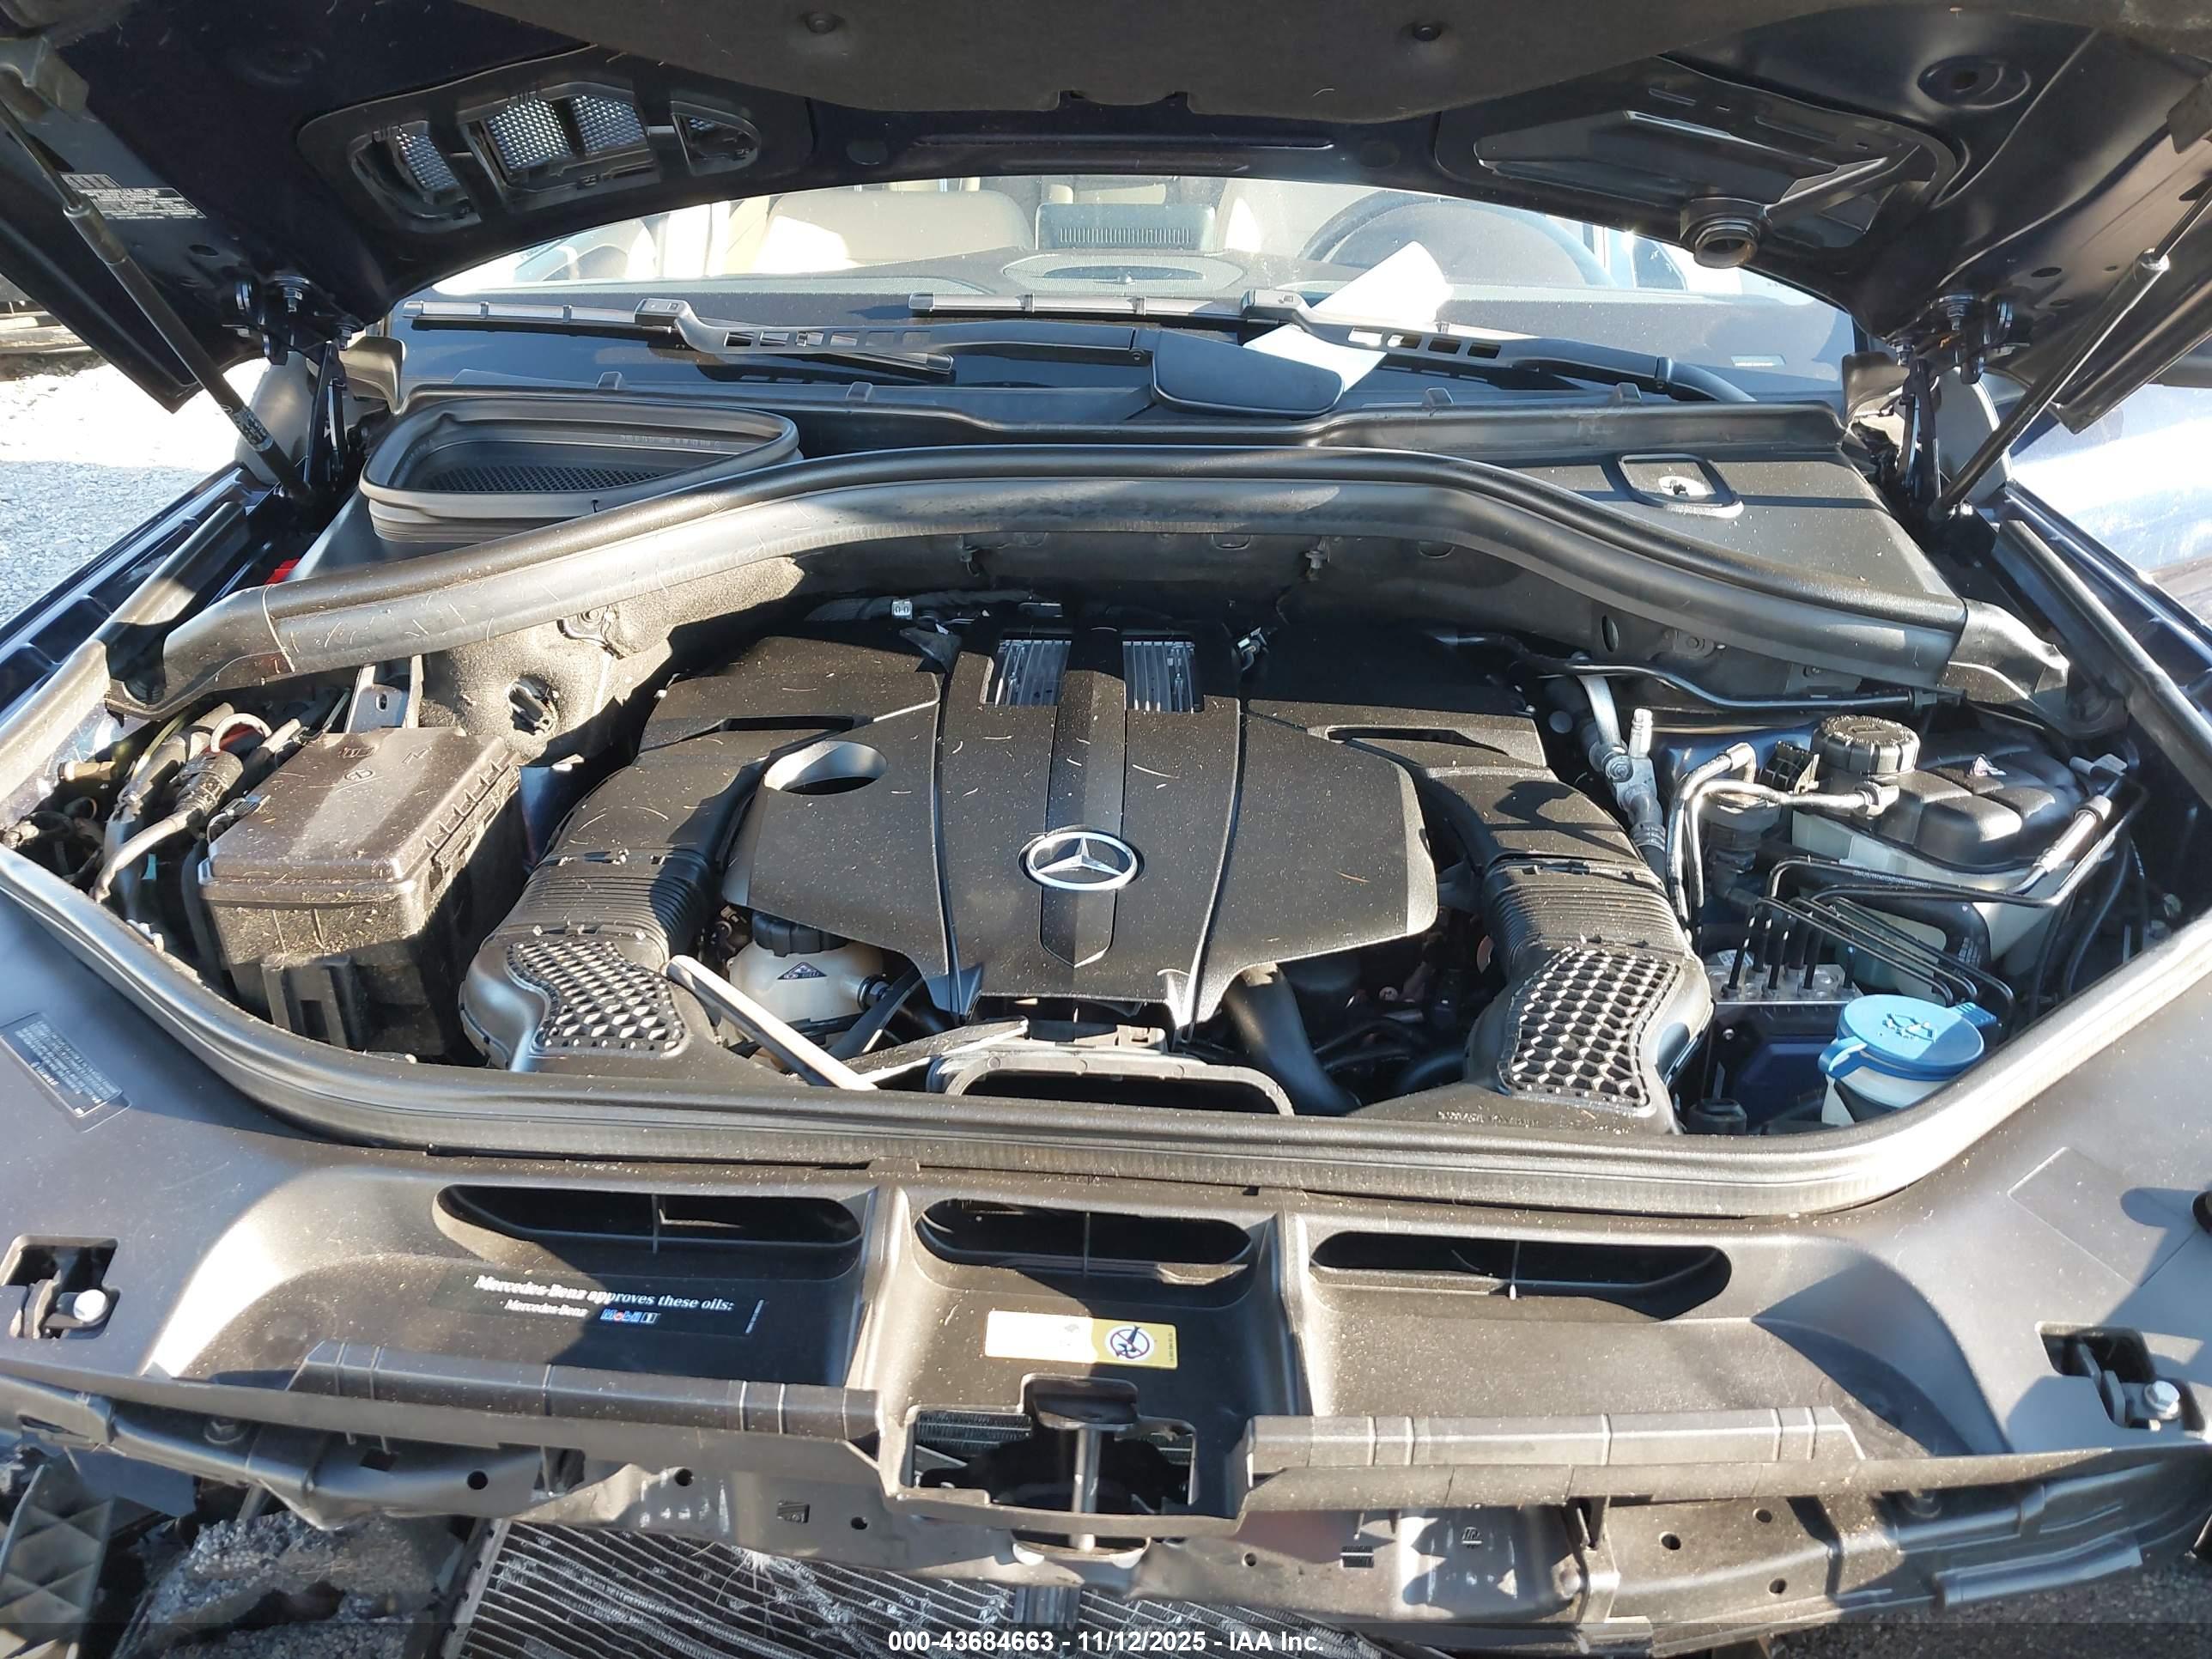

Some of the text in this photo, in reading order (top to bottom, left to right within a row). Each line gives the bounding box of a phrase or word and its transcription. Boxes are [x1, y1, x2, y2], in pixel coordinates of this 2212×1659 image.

[474, 1274, 735, 1311] Mercedes-Benz approves these oils:
[503, 1298, 590, 1317] Mercedes-Benz
[600, 1308, 642, 1323] Mobil
